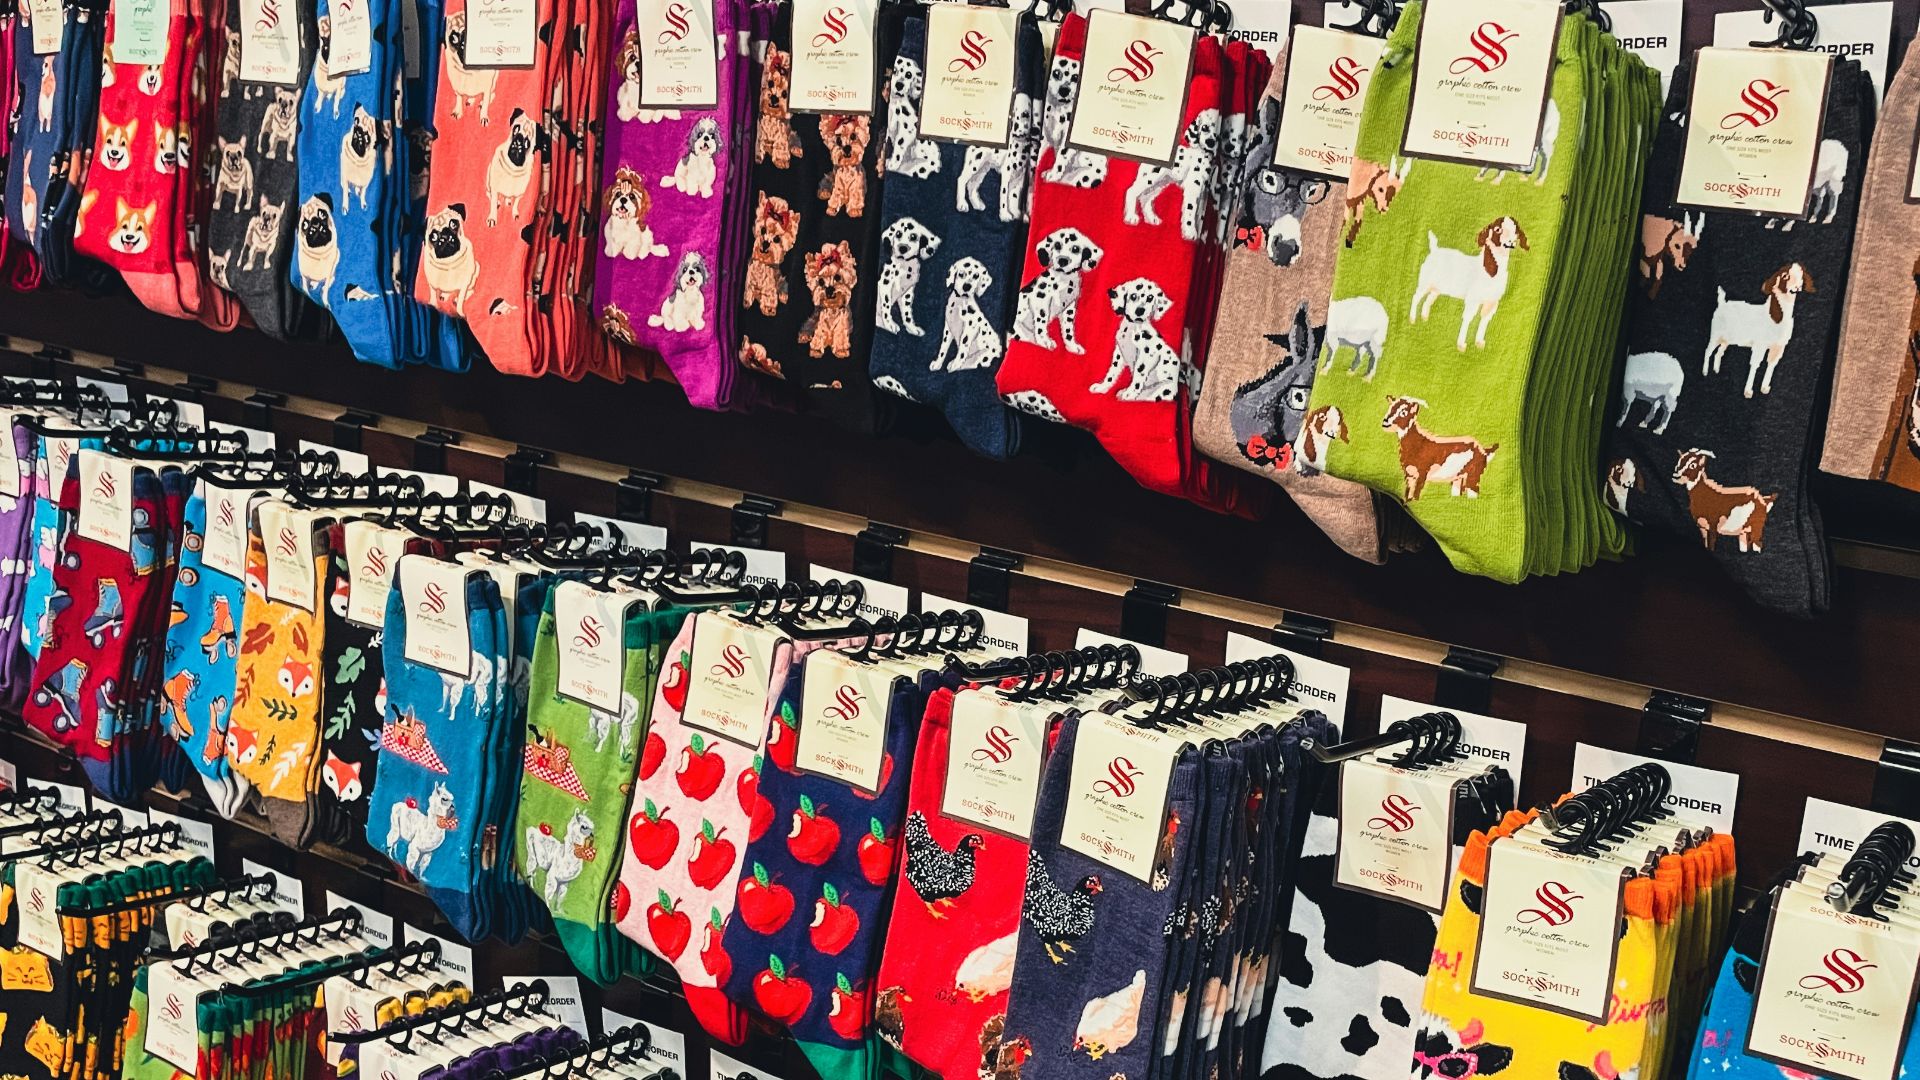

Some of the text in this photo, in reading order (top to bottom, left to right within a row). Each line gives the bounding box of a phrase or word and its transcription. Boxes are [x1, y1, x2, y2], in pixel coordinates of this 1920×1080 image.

[1437, 76, 1473, 93] graphic
[1474, 80, 1499, 91] cotton
[939, 115, 993, 131] SOCKSMITH
[1092, 126, 1154, 145] SOCKSMITH
[1433, 129, 1510, 148] SOCKSMITH
[1708, 132, 1743, 146] graphic
[1745, 135, 1770, 144] cotton
[1298, 147, 1354, 166] SOCKSMIT
[1704, 182, 1781, 199] SOCKSMITH
[962, 799, 1016, 822] SOCKSMITH
[1080, 832, 1136, 862] SOCKSMITH
[1814, 832, 1854, 851] TIME
[1359, 868, 1423, 893] SOCKSMITH
[1504, 924, 1540, 943] graphic
[1541, 932, 1567, 944] cotton
[1502, 970, 1580, 997] SOCKSMITH
[1784, 988, 1824, 1004] graphic
[1826, 1000, 1853, 1011] cotton
[1779, 1034, 1867, 1065] SOCKSMITH
